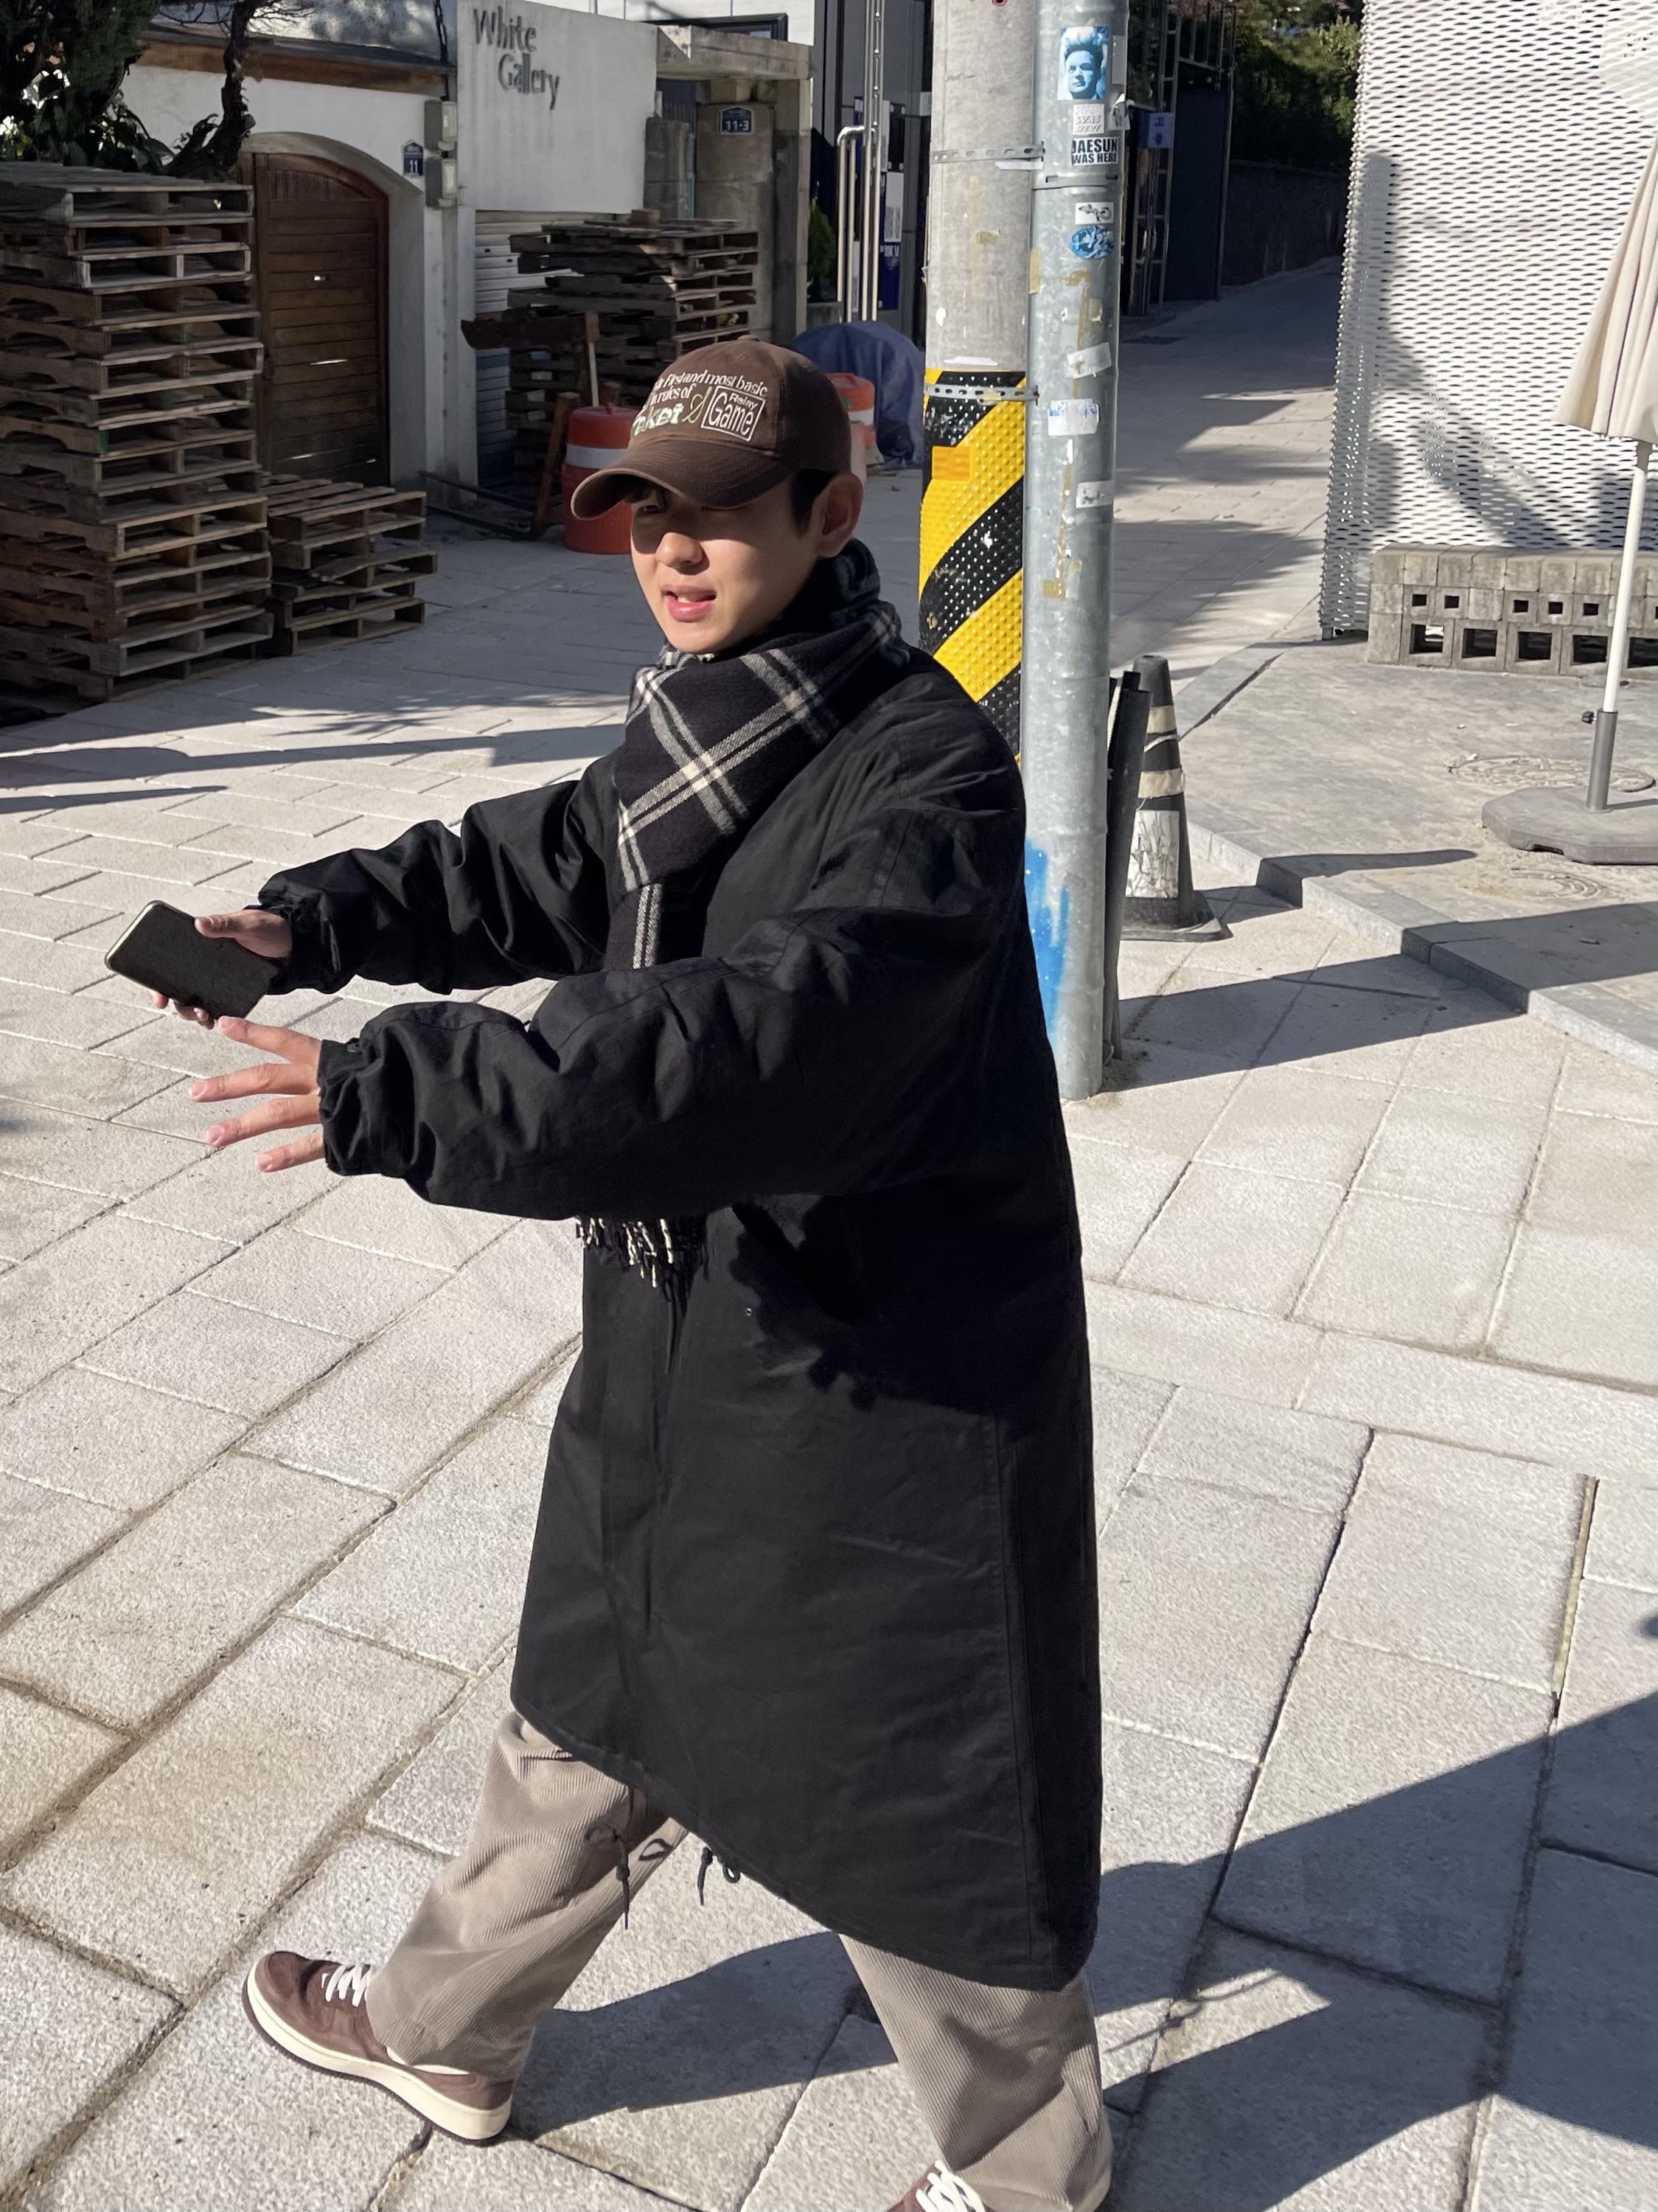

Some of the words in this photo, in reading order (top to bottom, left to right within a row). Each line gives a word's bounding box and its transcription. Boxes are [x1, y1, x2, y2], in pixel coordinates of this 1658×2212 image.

[473, 5, 537, 53] White
[498, 52, 560, 111] Gallery
[725, 120, 749, 131] 11-3
[1071, 139, 1118, 154] JAESUN
[409, 159, 418, 173] 11
[1072, 153, 1095, 164] WAS
[1097, 152, 1117, 163] HERE
[680, 383, 697, 398] of
[682, 369, 708, 383] and
[704, 374, 737, 387] most
[736, 375, 769, 397] basic
[729, 392, 758, 411] Relay
[708, 392, 753, 436] Game
